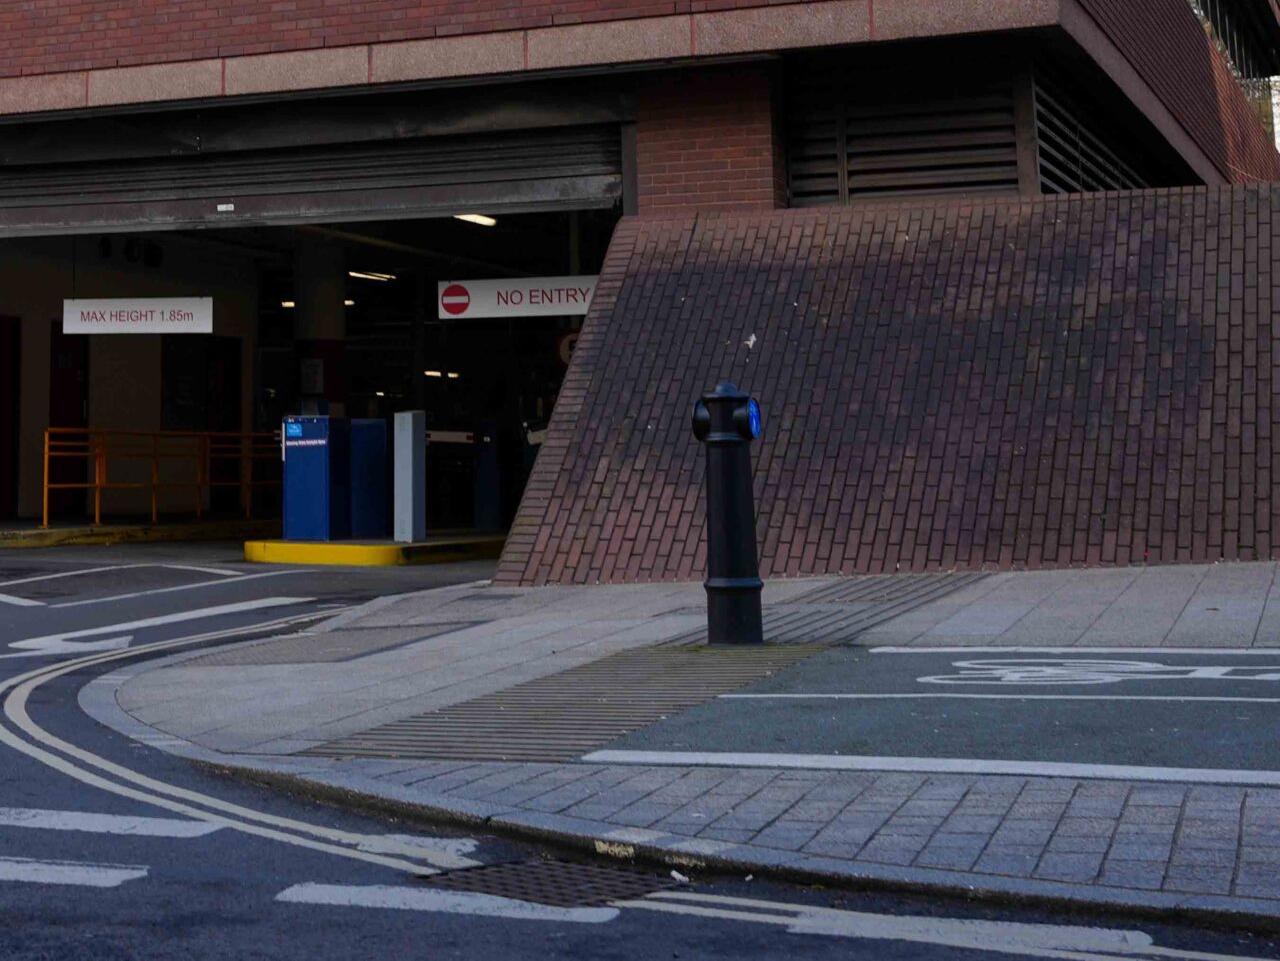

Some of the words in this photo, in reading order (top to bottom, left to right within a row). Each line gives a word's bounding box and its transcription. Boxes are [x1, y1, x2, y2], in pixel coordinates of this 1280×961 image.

[496, 289, 524, 306] NO
[529, 287, 590, 305] ENTRY
[80, 310, 106, 323] MAX
[109, 309, 156, 323] HEIGHT
[160, 309, 194, 322] 1.85m
